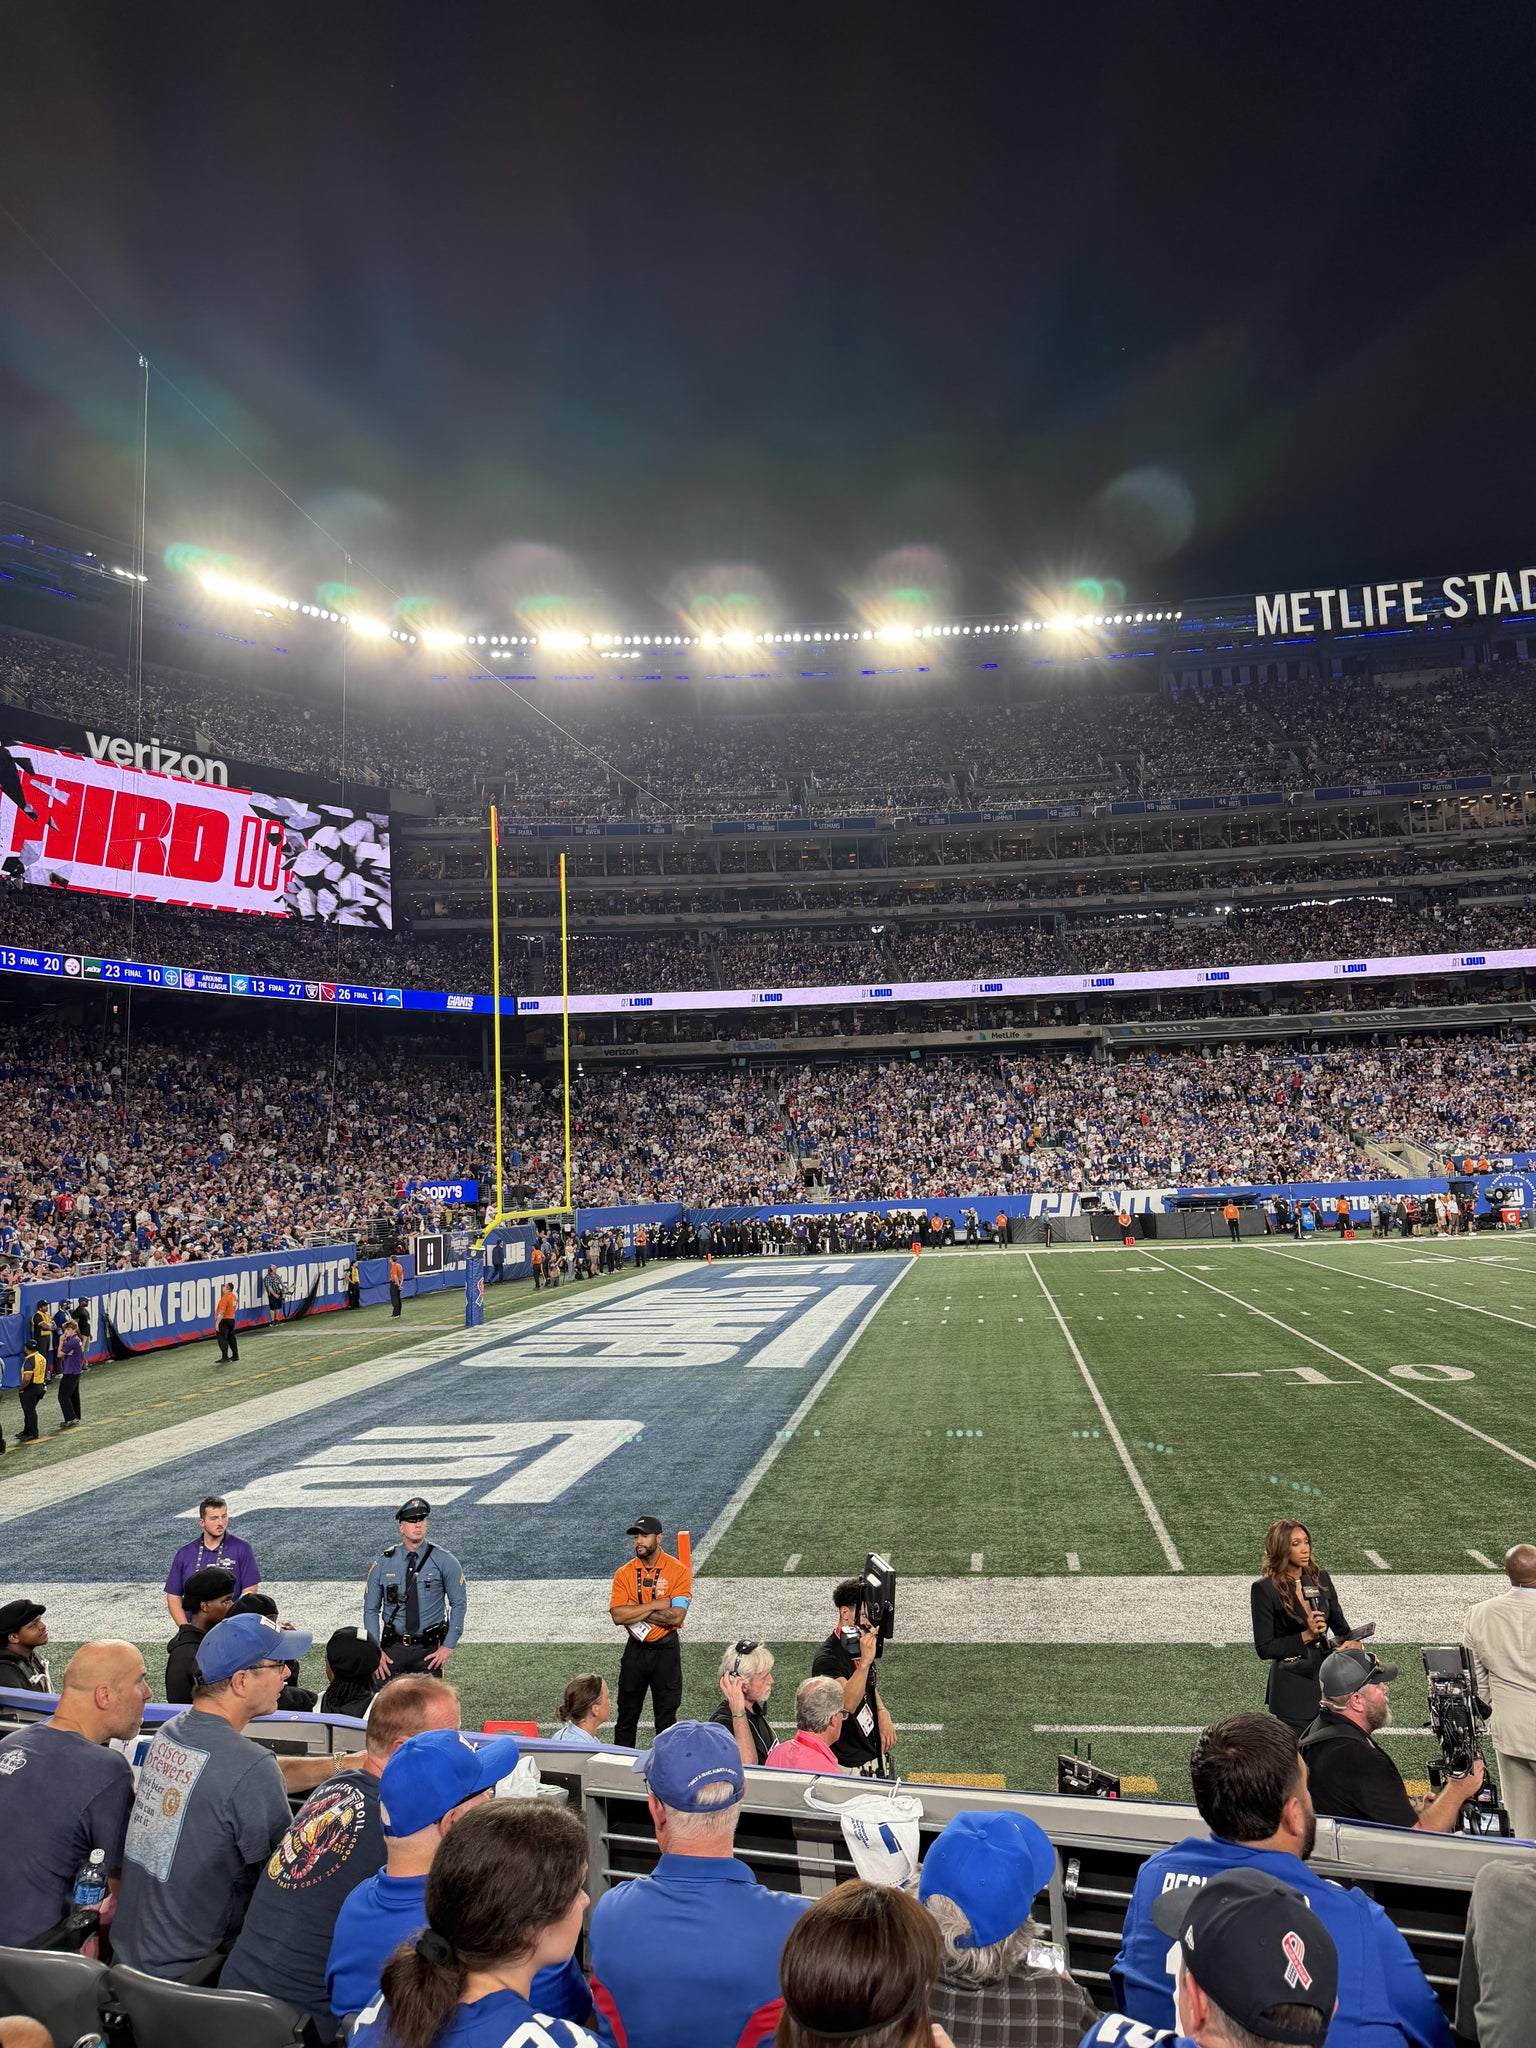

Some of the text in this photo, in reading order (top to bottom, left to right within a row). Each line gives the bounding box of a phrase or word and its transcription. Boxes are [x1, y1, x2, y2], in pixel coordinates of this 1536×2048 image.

[1255, 580, 1428, 636] METLIFE
[85, 731, 228, 787] verizon
[1432, 785, 1453, 793] PATTON
[9, 774, 231, 884] HIRD
[1, 951, 60, 972] 13 FINAL 20
[1460, 956, 1486, 967] LOUD
[105, 964, 161, 983] 23 FINAL 10
[1342, 963, 1368, 974] LOUD
[201, 974, 224, 984] AROUND
[1205, 971, 1231, 982] LOUD
[197, 981, 228, 991] THE LEAGUE
[251, 980, 302, 996] 13 FINAL 27
[979, 983, 1003, 993] LOUD
[1090, 977, 1115, 988] LOUD
[338, 989, 384, 1003] 26 FINAL 14
[759, 993, 783, 1003] LOUD
[869, 988, 893, 998] LOUD
[447, 995, 474, 1009] GIANTS
[518, 1000, 540, 1011] OUD
[629, 997, 653, 1008] LOUD
[1344, 1013, 1401, 1024] MetLife
[1145, 1024, 1201, 1035] MetLife
[991, 1031, 1021, 1040] MetLife
[603, 1047, 640, 1058] verizon
[1506, 1212, 1517, 1222] G
[1346, 1231, 1355, 1239] 20
[1126, 1237, 1135, 1246] 10
[102, 1284, 164, 1338] YORK
[1264, 1364, 1477, 1386] 10
[146, 1743, 193, 1785] brewers
[152, 1779, 165, 1794] beer
[143, 1804, 155, 1817] can
[143, 1815, 149, 1827] it
[354, 1801, 366, 1833] BOIL
[276, 1879, 297, 1890] THAT'S
